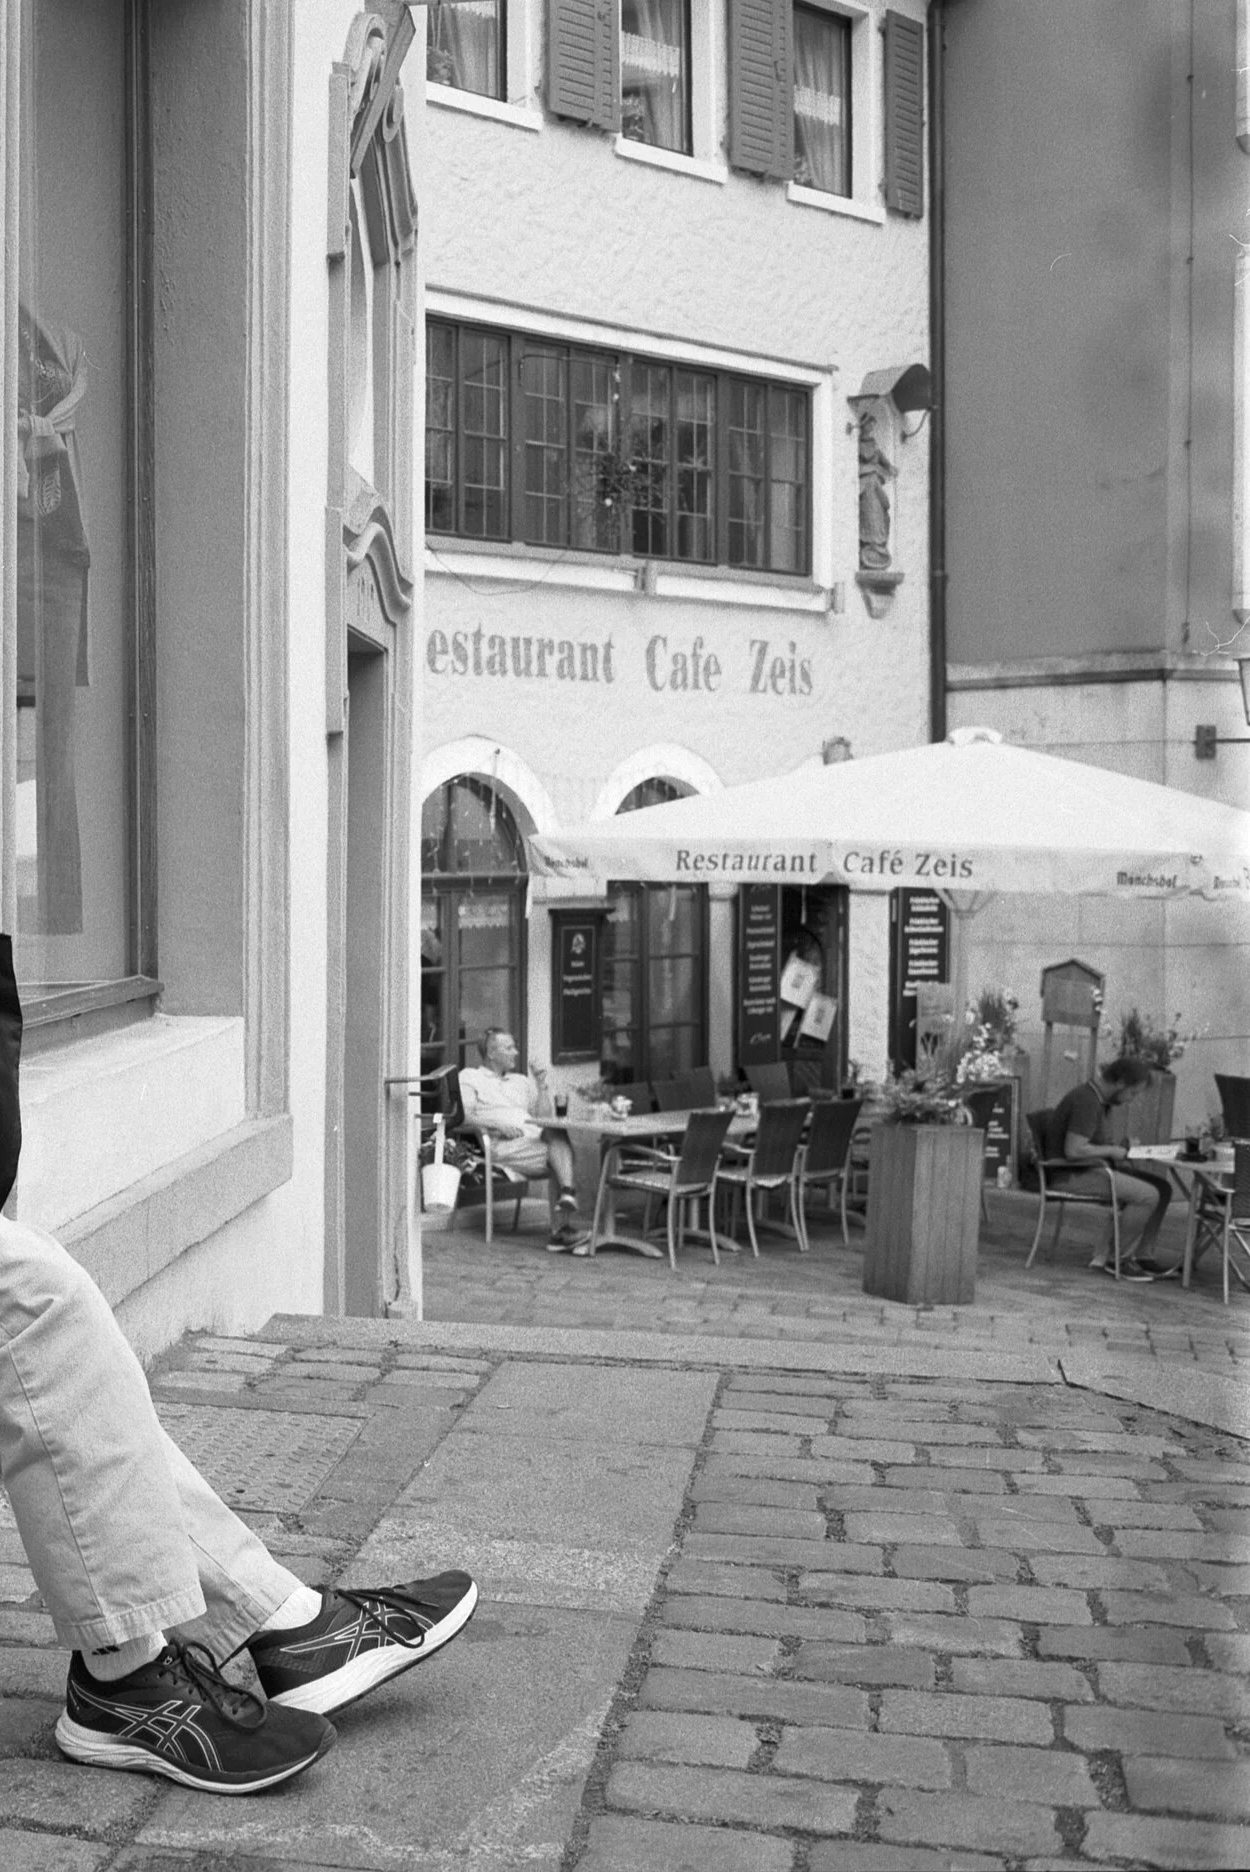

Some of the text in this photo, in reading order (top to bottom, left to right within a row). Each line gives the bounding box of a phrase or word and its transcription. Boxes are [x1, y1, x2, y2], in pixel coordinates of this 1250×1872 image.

[425, 622, 814, 696] estaurant Cafe Zeis
[675, 848, 975, 878] Restaurant Café Zeis
